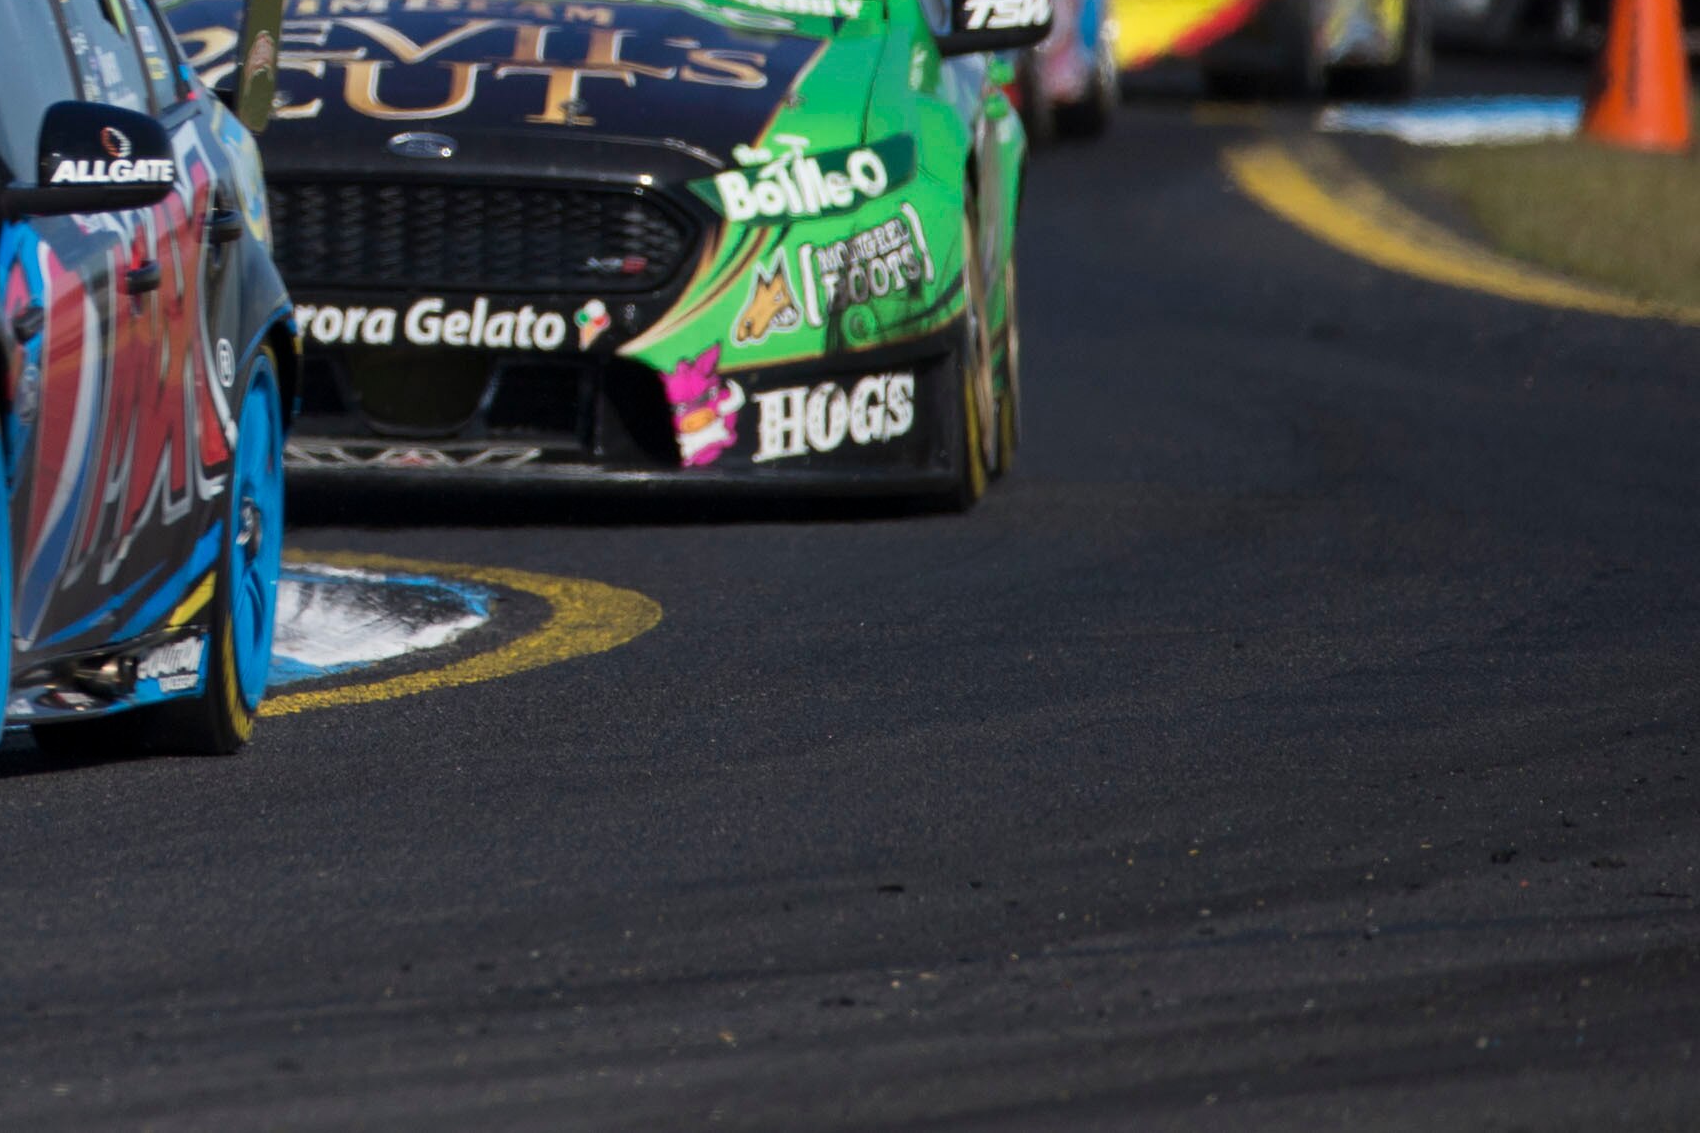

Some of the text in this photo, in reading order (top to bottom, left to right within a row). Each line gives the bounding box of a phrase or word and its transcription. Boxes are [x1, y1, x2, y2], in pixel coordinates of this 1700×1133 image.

[51, 159, 174, 184] ALLGATE
[404, 295, 566, 351] Gelato
[753, 373, 915, 463] HOGS
